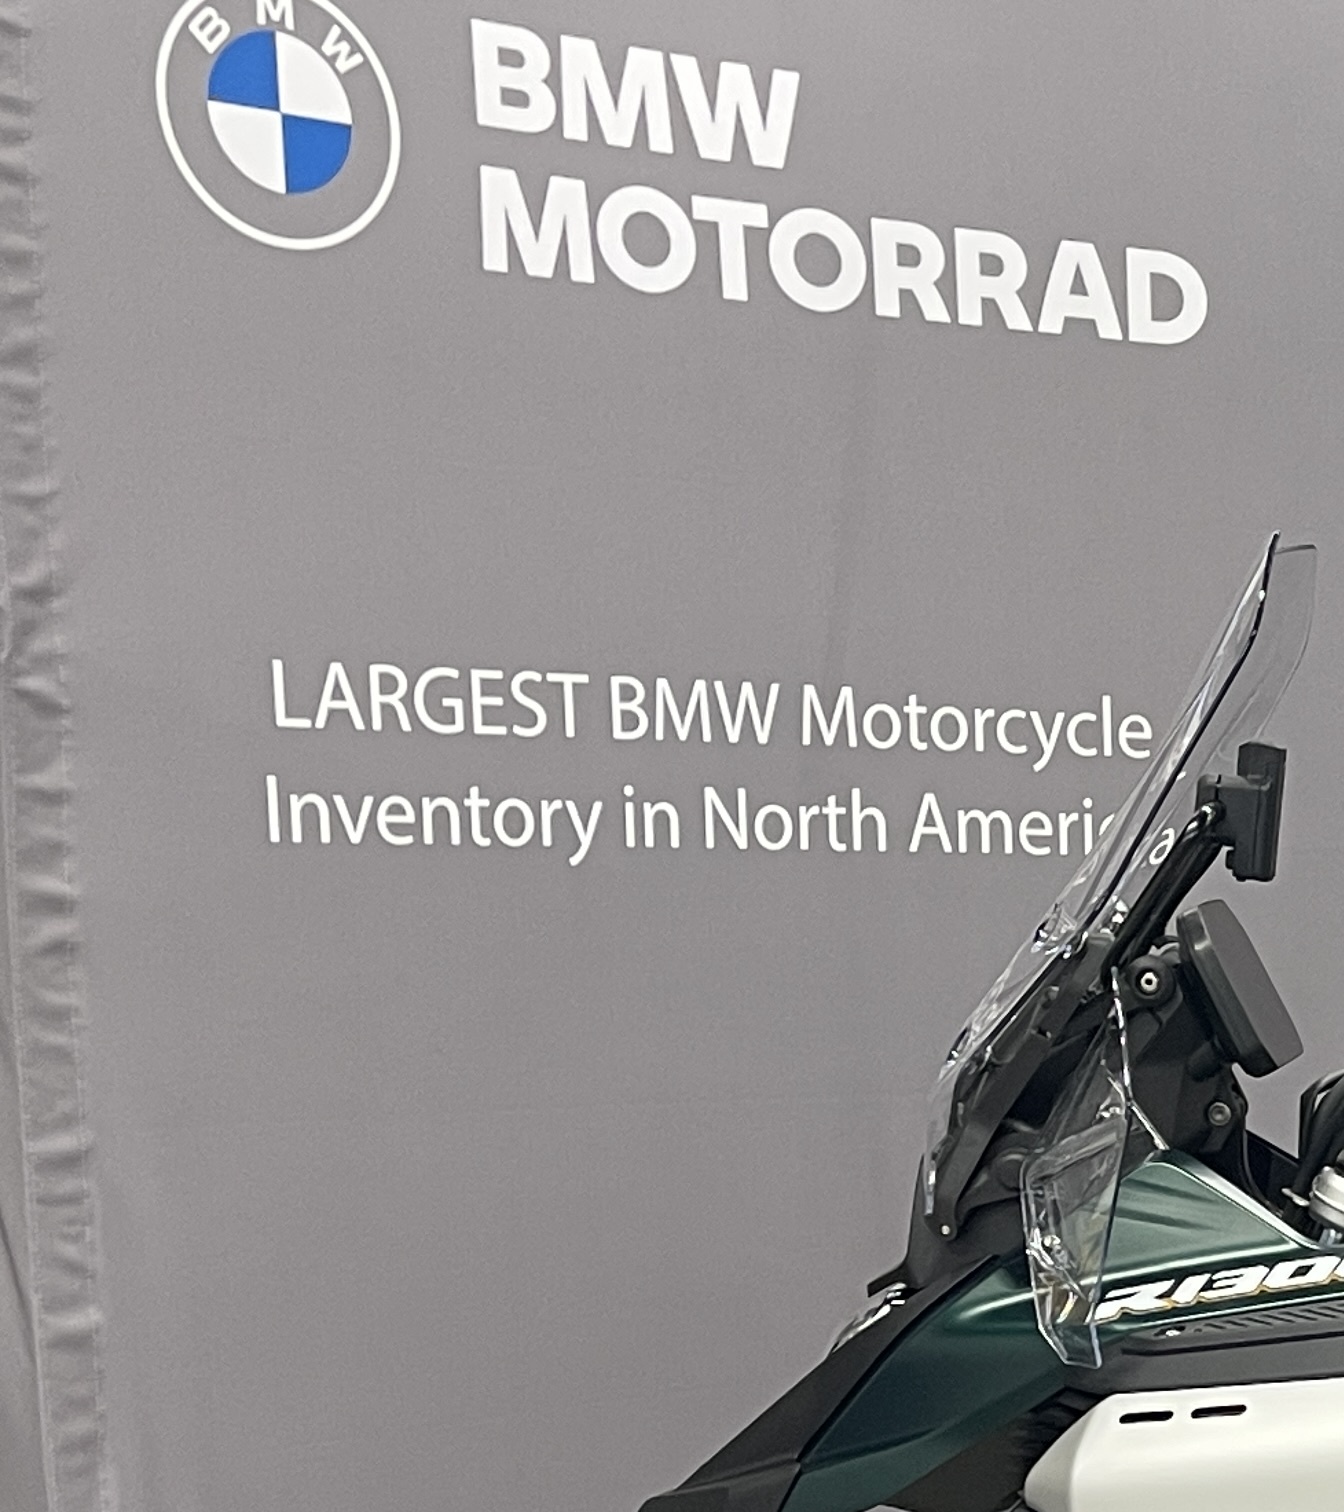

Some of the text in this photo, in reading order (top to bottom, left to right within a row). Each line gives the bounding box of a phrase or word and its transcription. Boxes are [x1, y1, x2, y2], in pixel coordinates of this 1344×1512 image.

[188, 0, 365, 75] BMW
[470, 18, 801, 170] BMW
[478, 164, 1209, 346] MOTORRAD
[270, 658, 1154, 773] LARGEST BMW Motorcycle
[264, 774, 1177, 867] Inventory in North Ameria
